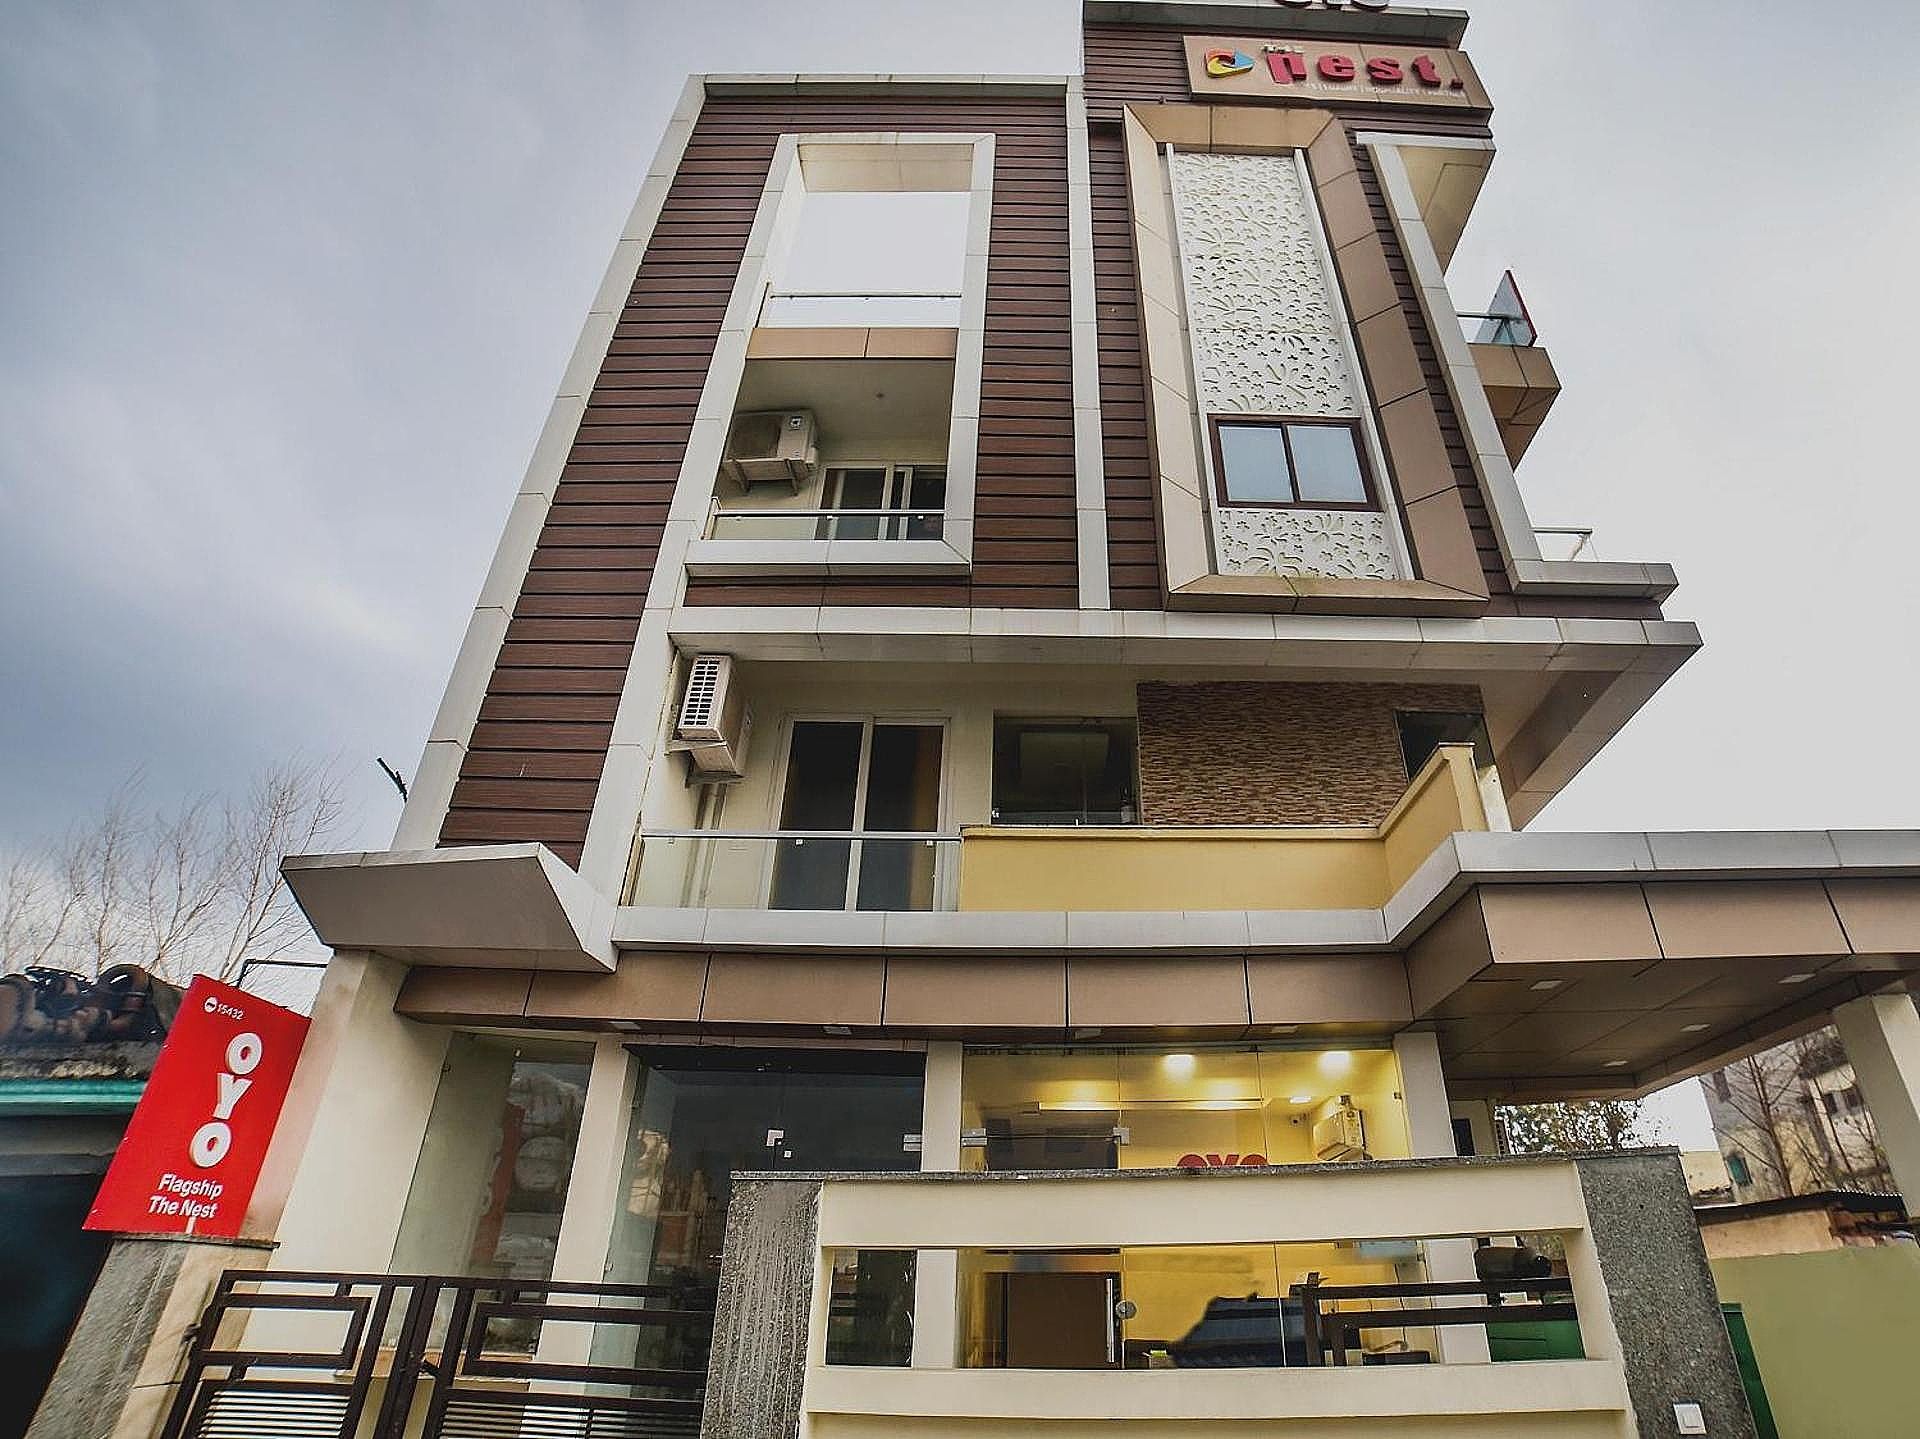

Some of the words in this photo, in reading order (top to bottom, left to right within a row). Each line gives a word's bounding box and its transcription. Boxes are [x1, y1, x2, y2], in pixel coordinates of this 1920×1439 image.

[217, 1003, 244, 1020] 15432
[188, 1031, 263, 1168] OYO
[157, 1173, 224, 1200] Flagship
[148, 1195, 180, 1215] The
[179, 1199, 218, 1218] Nest
